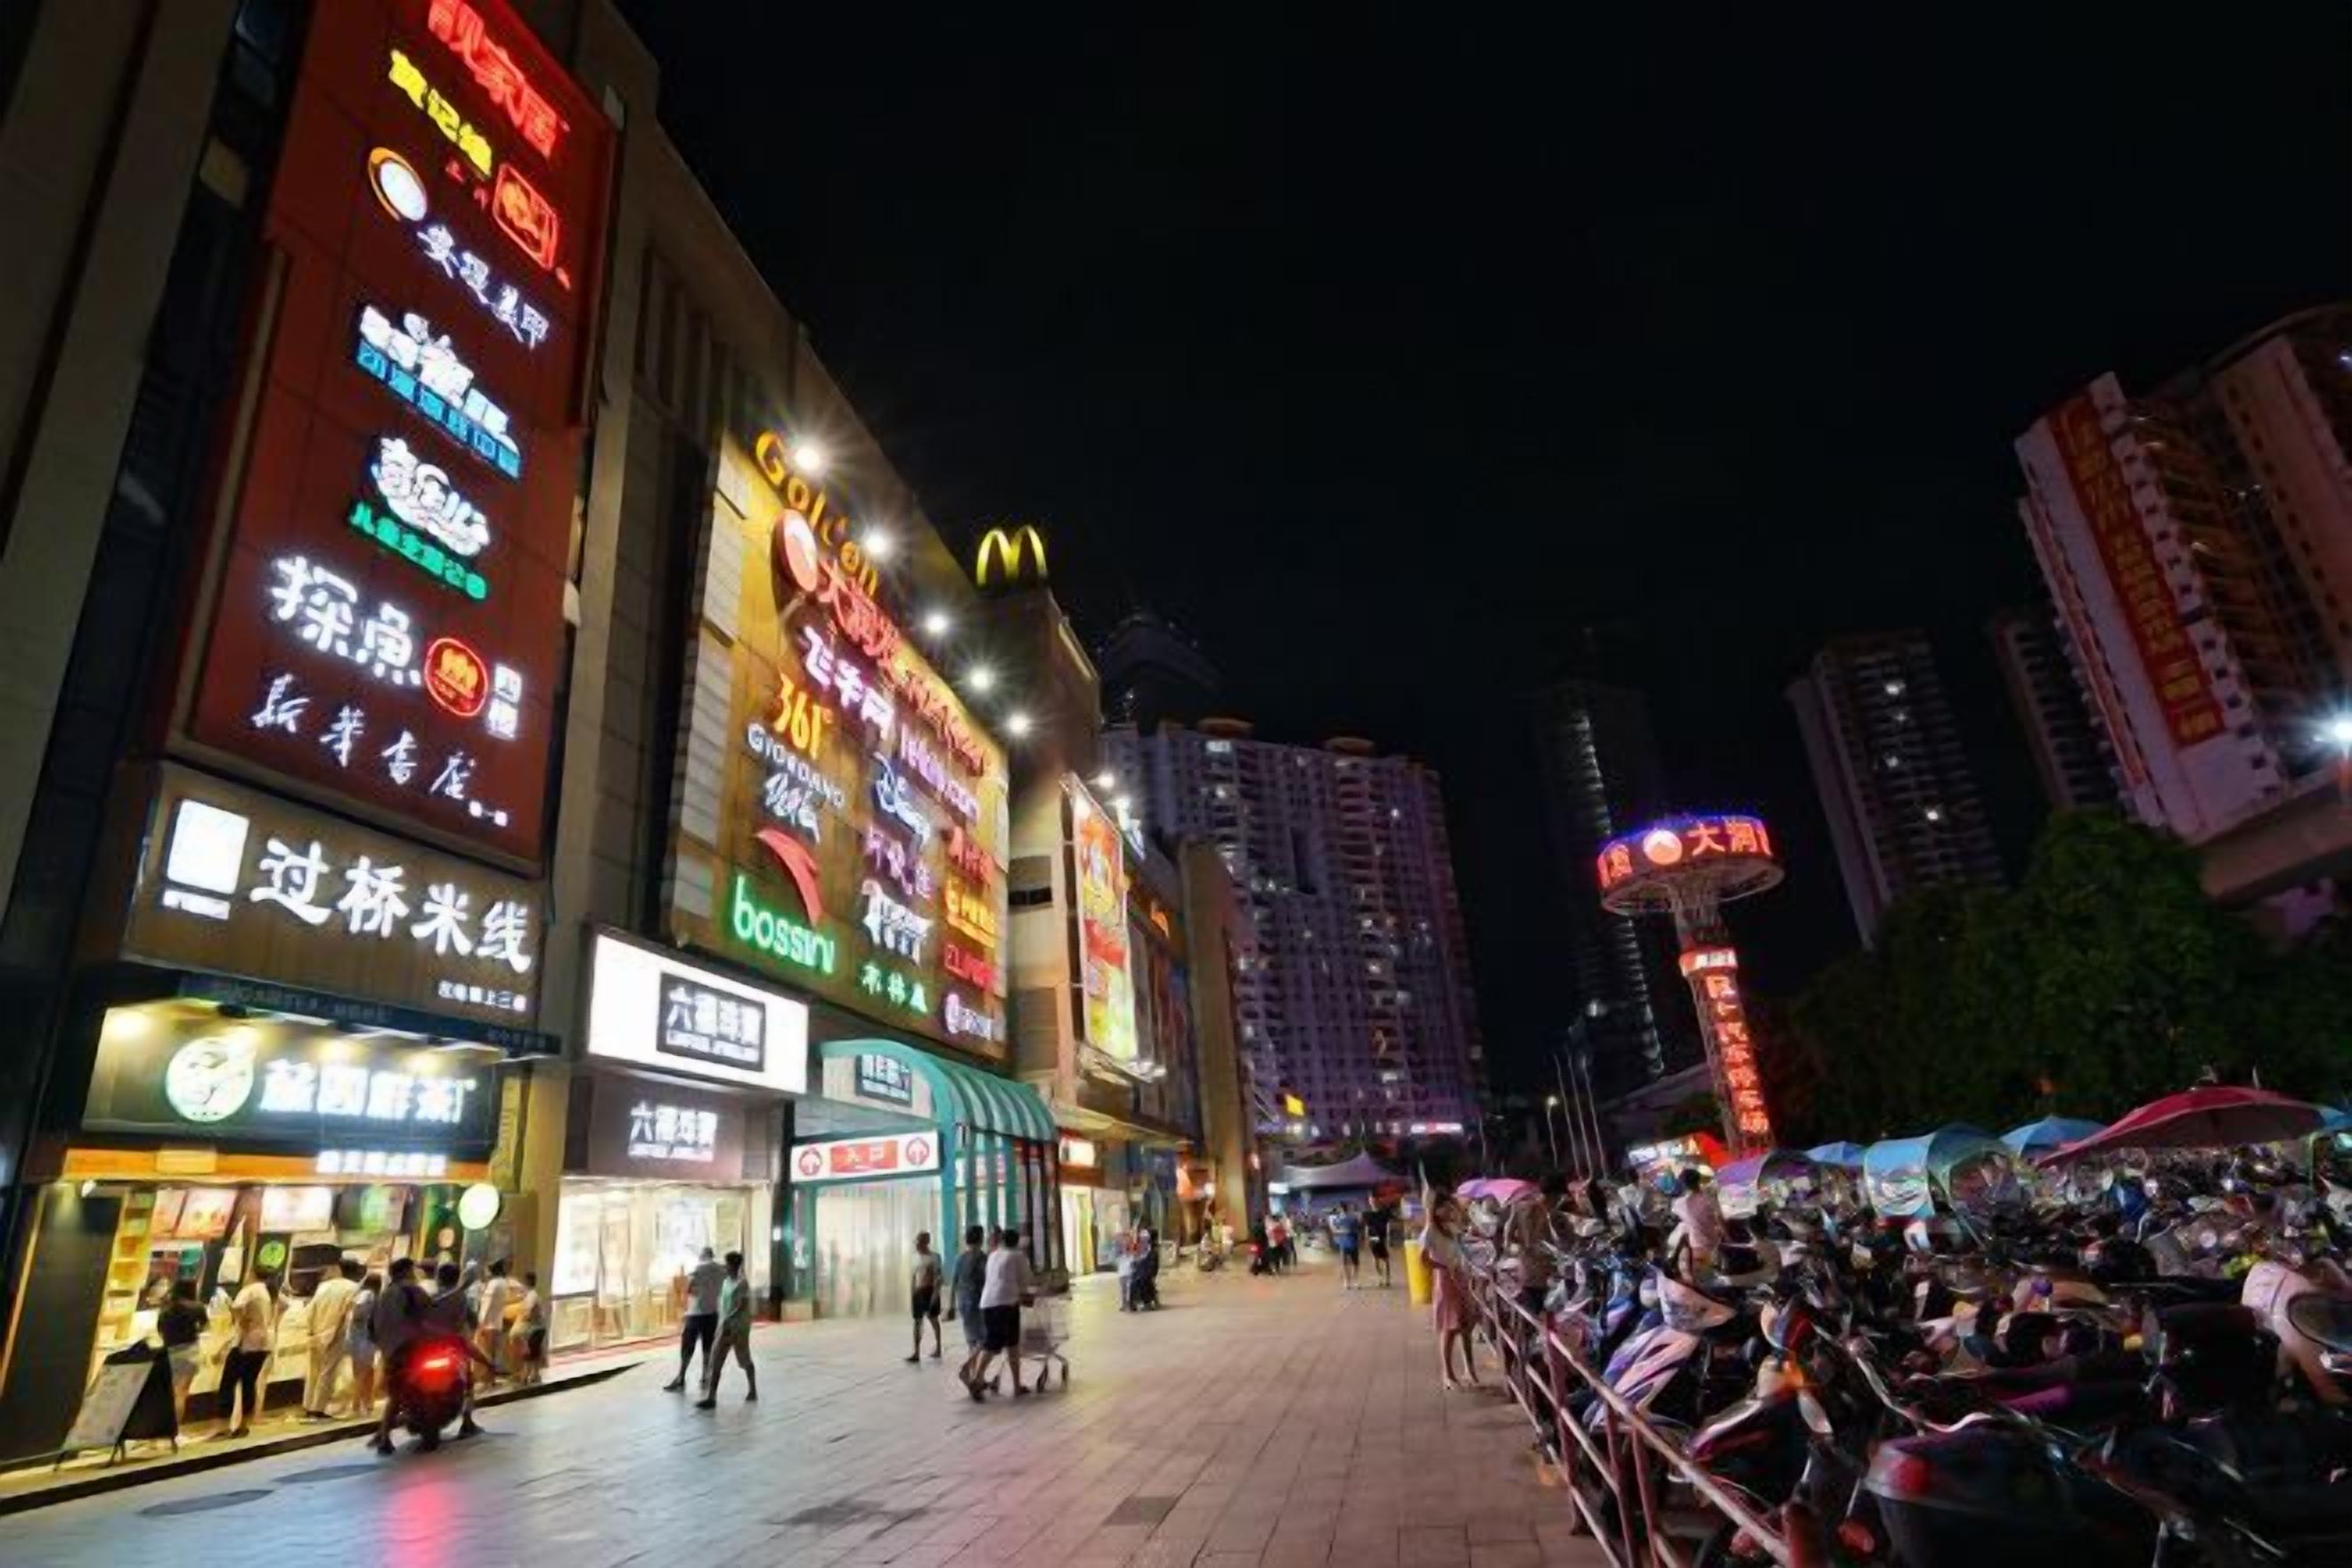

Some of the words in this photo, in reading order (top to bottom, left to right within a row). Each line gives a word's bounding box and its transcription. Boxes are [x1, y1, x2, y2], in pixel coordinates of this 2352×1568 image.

[270, 555, 421, 685] 探鱼
[250, 838, 532, 974] 过桥米线
